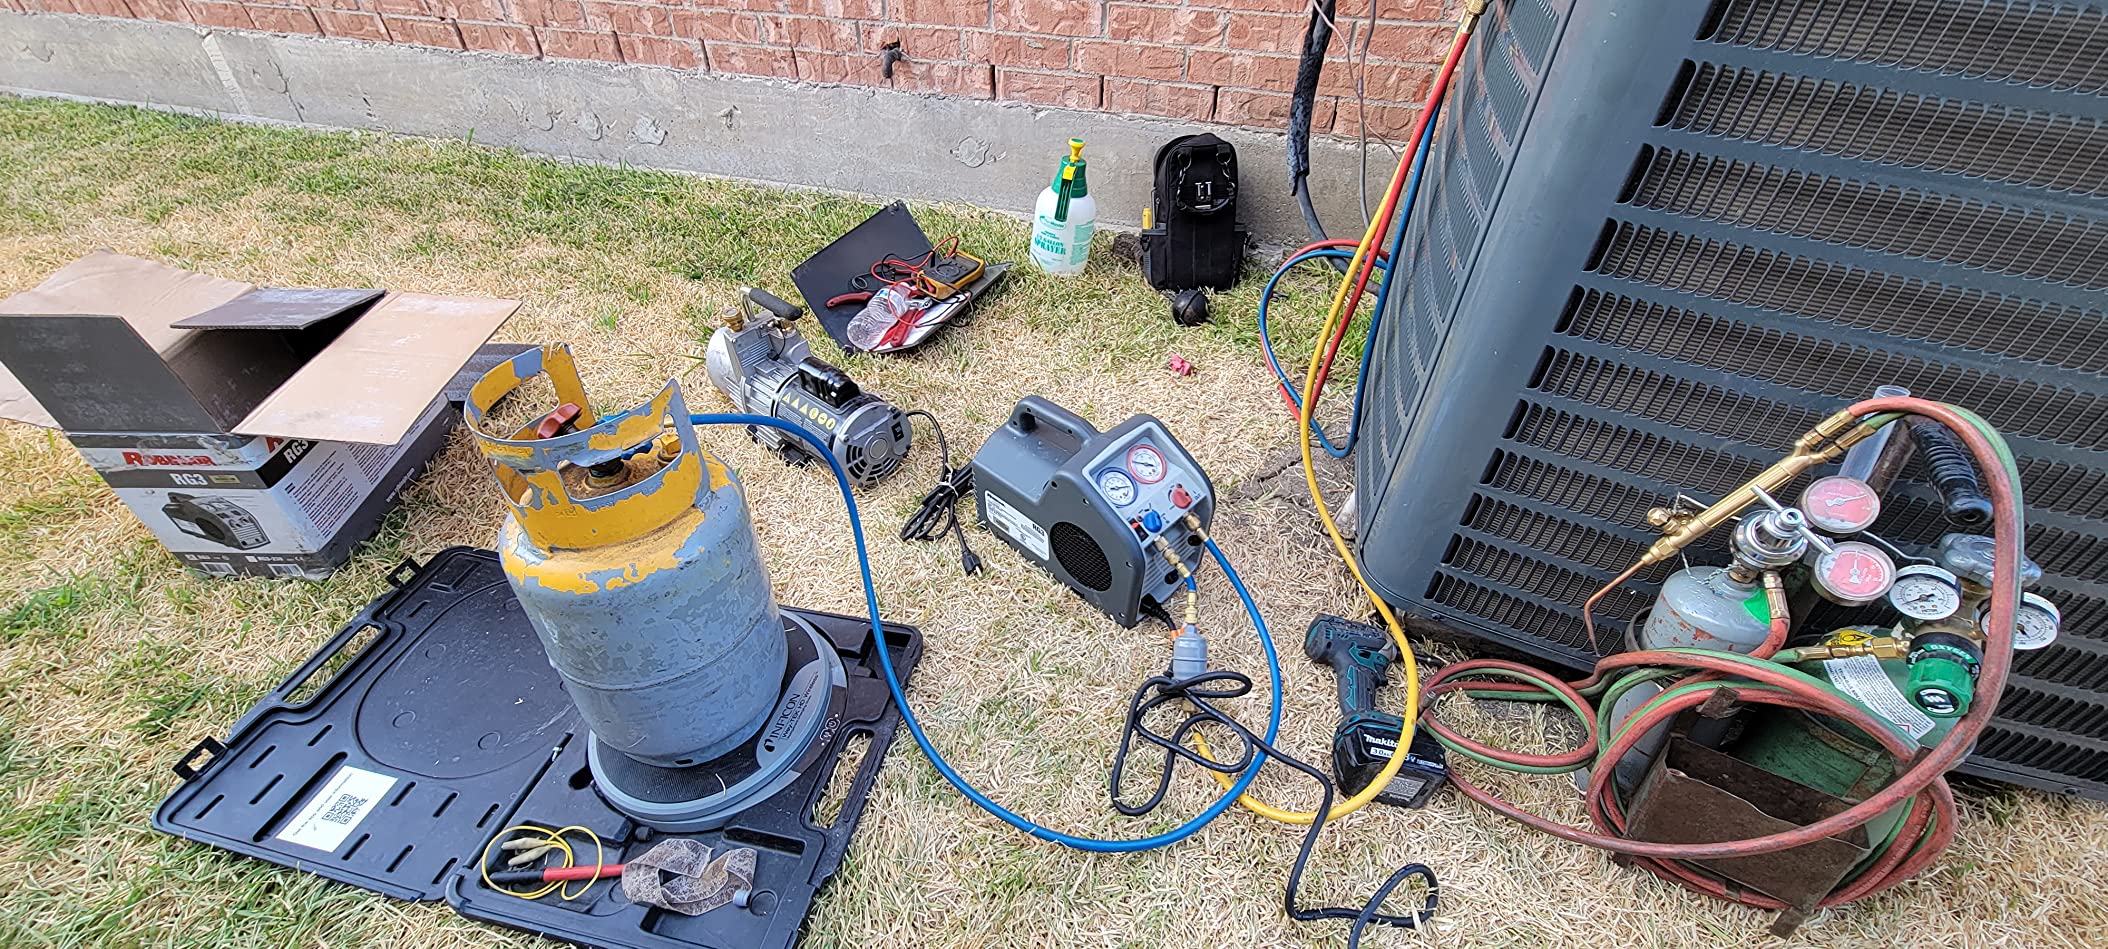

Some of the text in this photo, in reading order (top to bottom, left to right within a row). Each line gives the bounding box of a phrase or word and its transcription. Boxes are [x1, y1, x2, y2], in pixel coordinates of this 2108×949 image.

[283, 440, 309, 464] RG3
[169, 473, 208, 486] RG3
[1930, 644, 1971, 660] OXYGEN
[769, 693, 801, 739] INFICON
